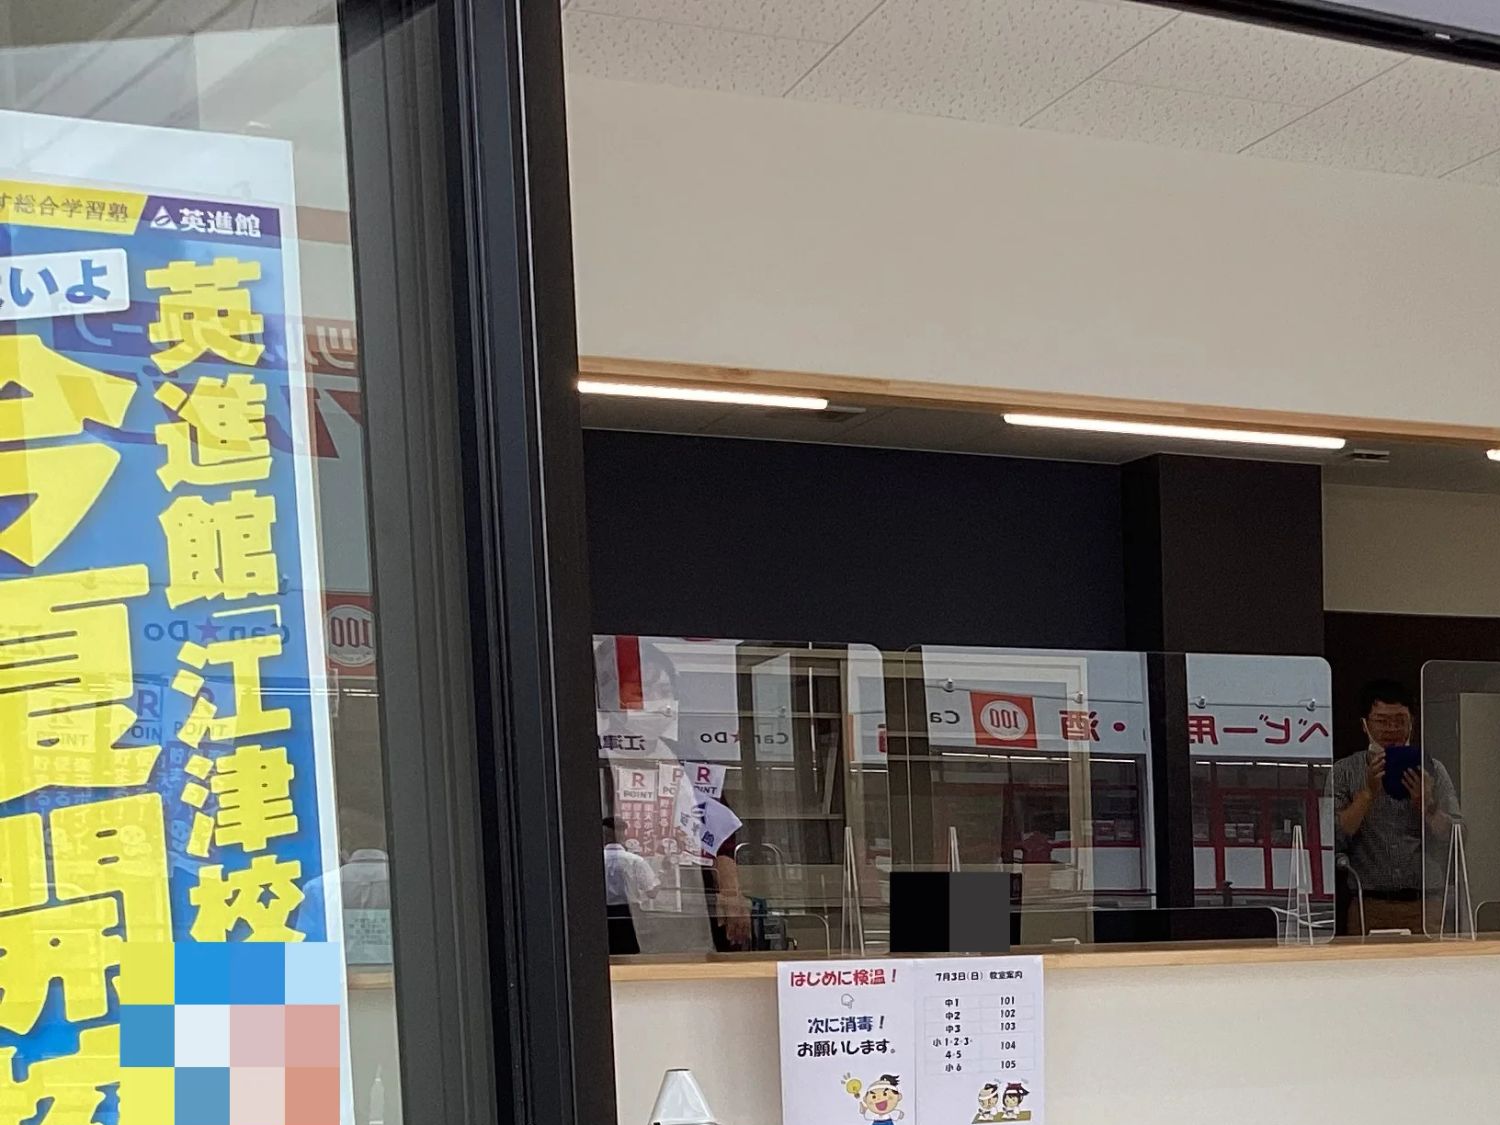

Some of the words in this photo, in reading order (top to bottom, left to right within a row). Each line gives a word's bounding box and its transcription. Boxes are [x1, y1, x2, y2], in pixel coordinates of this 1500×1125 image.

[179, 207, 262, 238] 英進館
[0, 257, 111, 308] いよ
[790, 968, 897, 986] はじめに検温！
[1000, 996, 1015, 1005] 101
[1000, 1009, 1016, 1018] 102
[807, 1016, 885, 1033] 次に消毒！
[1000, 1022, 1016, 1031] 103
[797, 1038, 896, 1057] お願いします。
[1000, 1041, 1016, 1050] 104
[1000, 1060, 1016, 1069] 105
